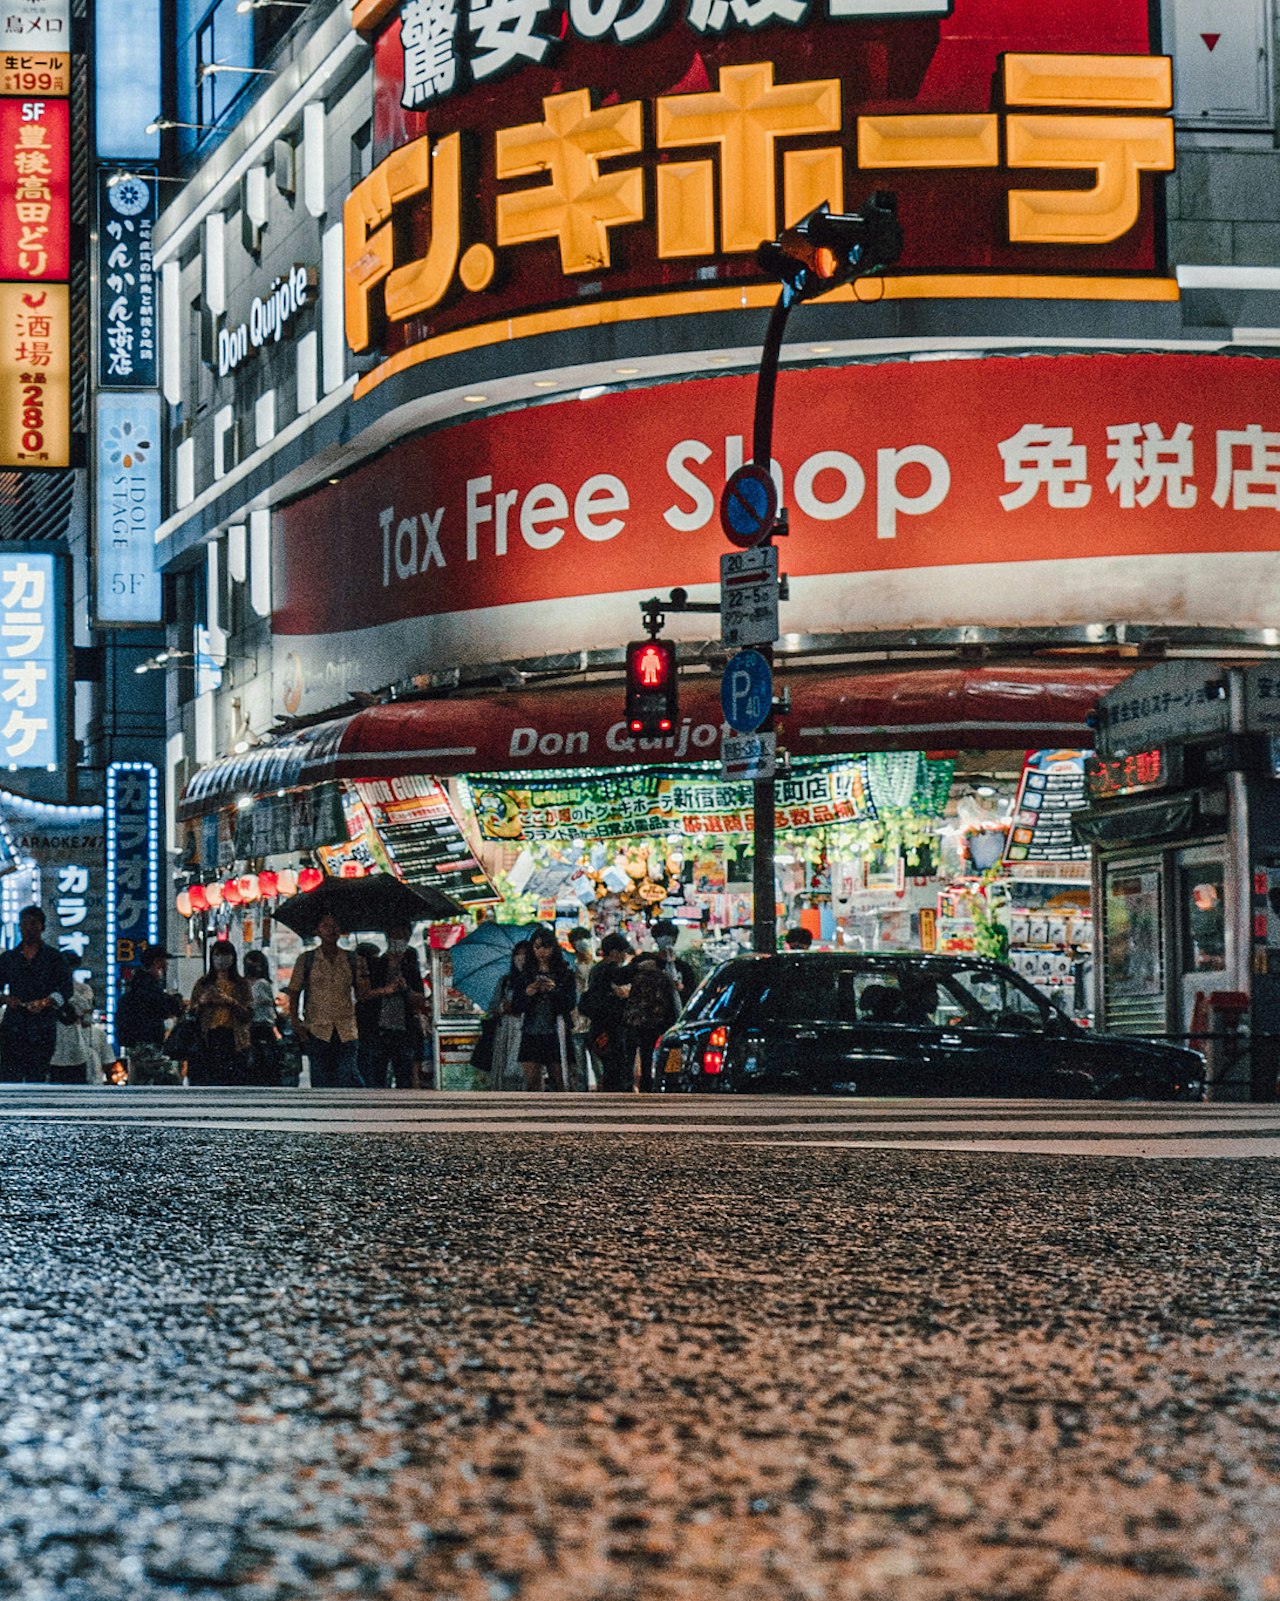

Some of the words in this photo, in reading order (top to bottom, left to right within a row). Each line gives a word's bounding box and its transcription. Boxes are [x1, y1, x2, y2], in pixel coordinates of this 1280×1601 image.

[4, 15, 64, 34] 鳥メロ
[3, 56, 63, 70] 生ビール
[21, 102, 45, 121] 5F
[13, 124, 53, 276] 豊後高田どり
[15, 312, 54, 366] 酒場
[218, 321, 249, 378] Don
[249, 264, 308, 349] Quijote
[21, 385, 45, 452] 280
[997, 423, 1280, 512] 免税店
[112, 476, 129, 549] STAGE
[130, 476, 147, 536] IDOL
[378, 504, 447, 589] Tax
[464, 462, 632, 560] Free
[112, 572, 146, 595] 5F
[1, 561, 48, 758] カラオケ
[731, 670, 751, 721] P
[508, 726, 590, 758] Don
[9, 836, 80, 850] KARAOKE
